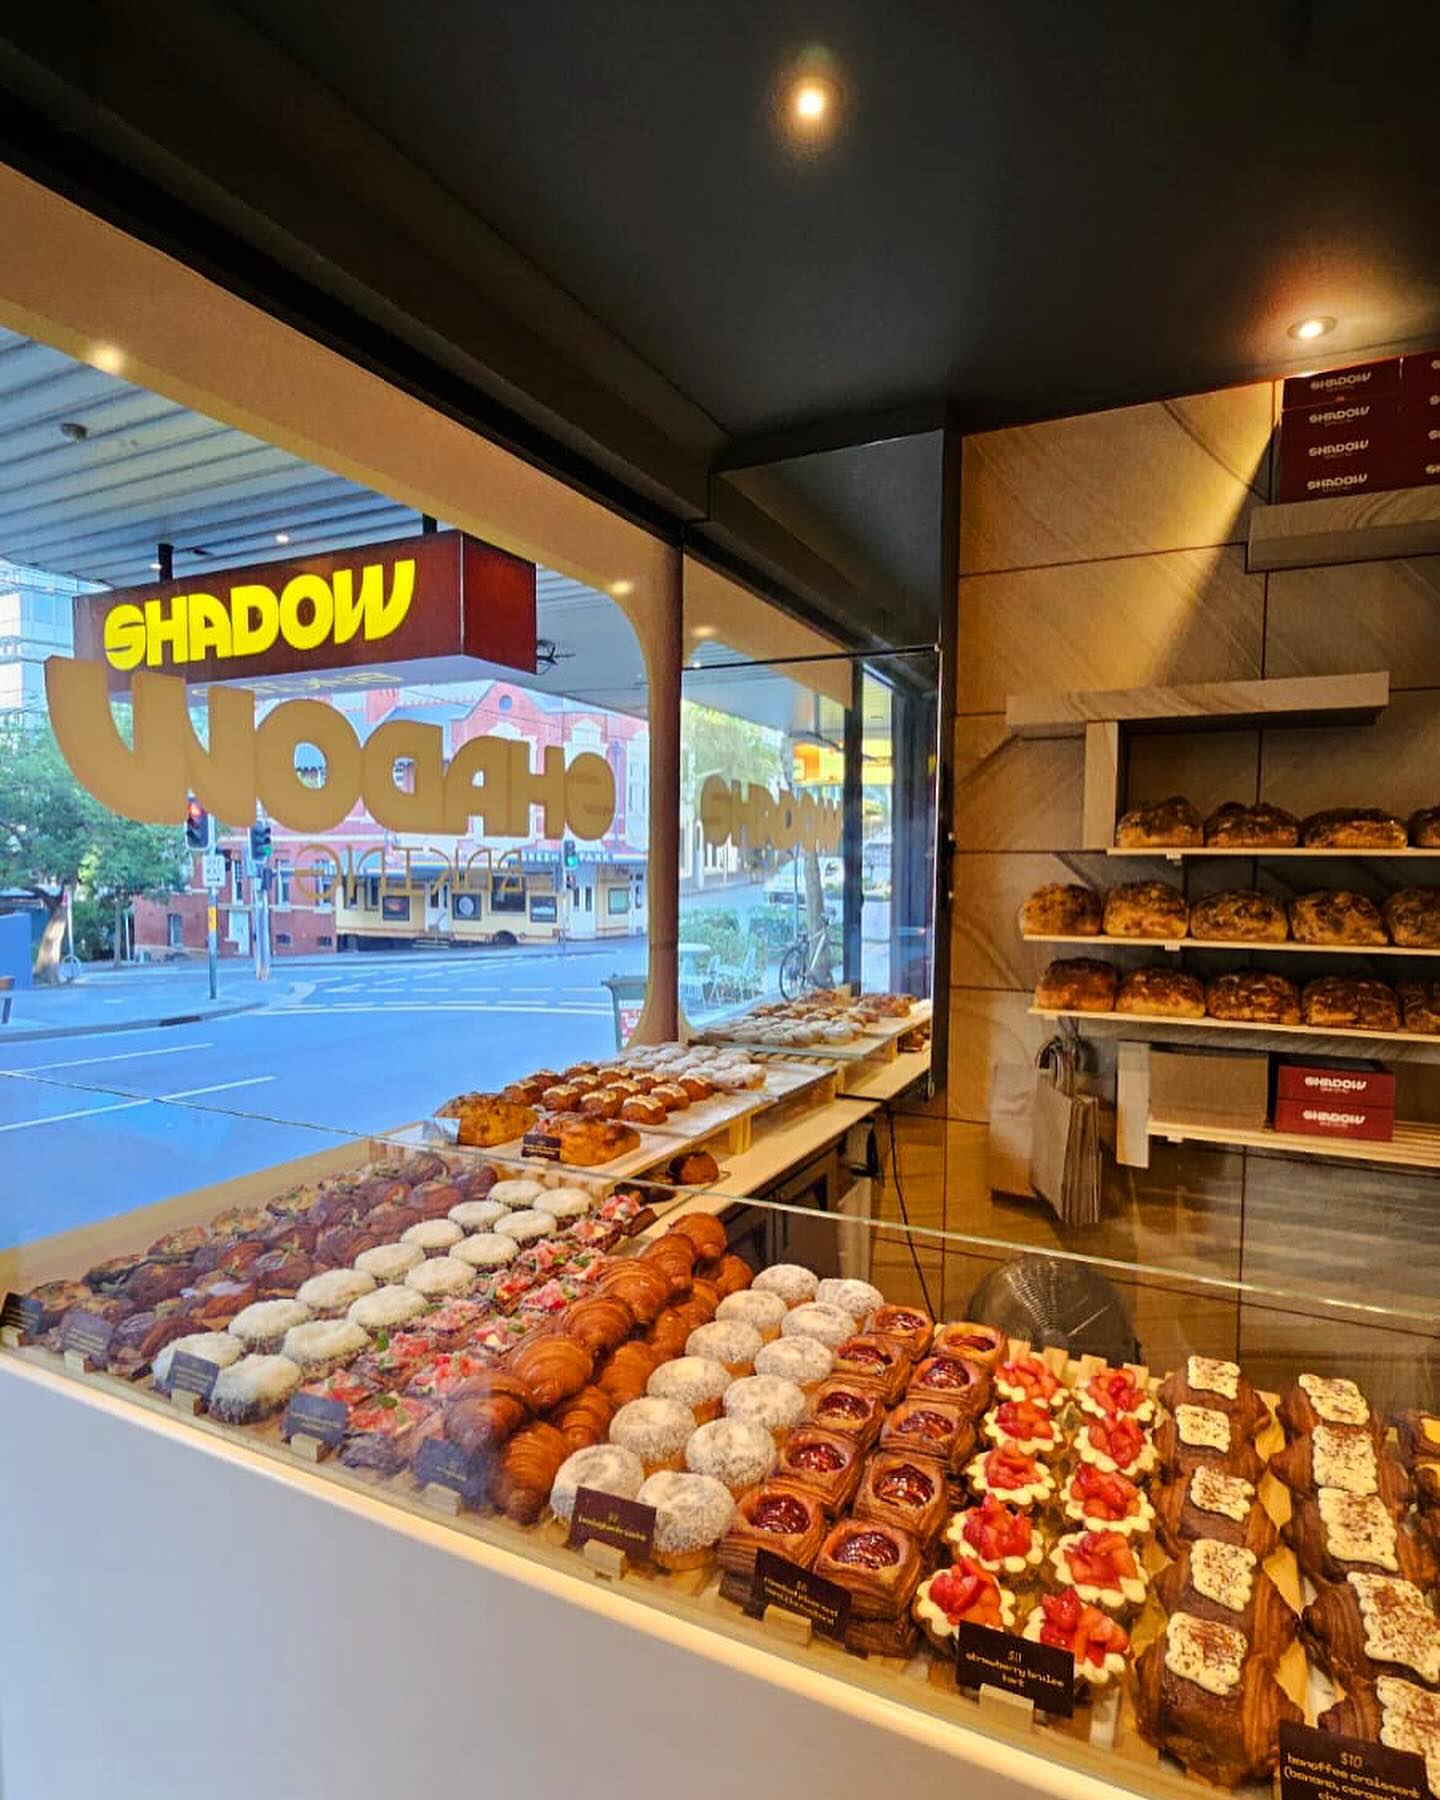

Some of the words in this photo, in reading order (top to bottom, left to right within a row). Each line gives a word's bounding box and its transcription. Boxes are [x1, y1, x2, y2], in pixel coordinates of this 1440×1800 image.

[1309, 405, 1370, 424] SHADOW
[1308, 438, 1369, 457] SHADOW
[1306, 473, 1368, 491] SHADOW
[104, 559, 415, 670] SHADOW
[1305, 1076, 1367, 1090] SHADOW
[1303, 1110, 1366, 1125] SHADOW
[1287, 1752, 1348, 1780] banoffee
[1340, 1752, 1363, 1769] $10
